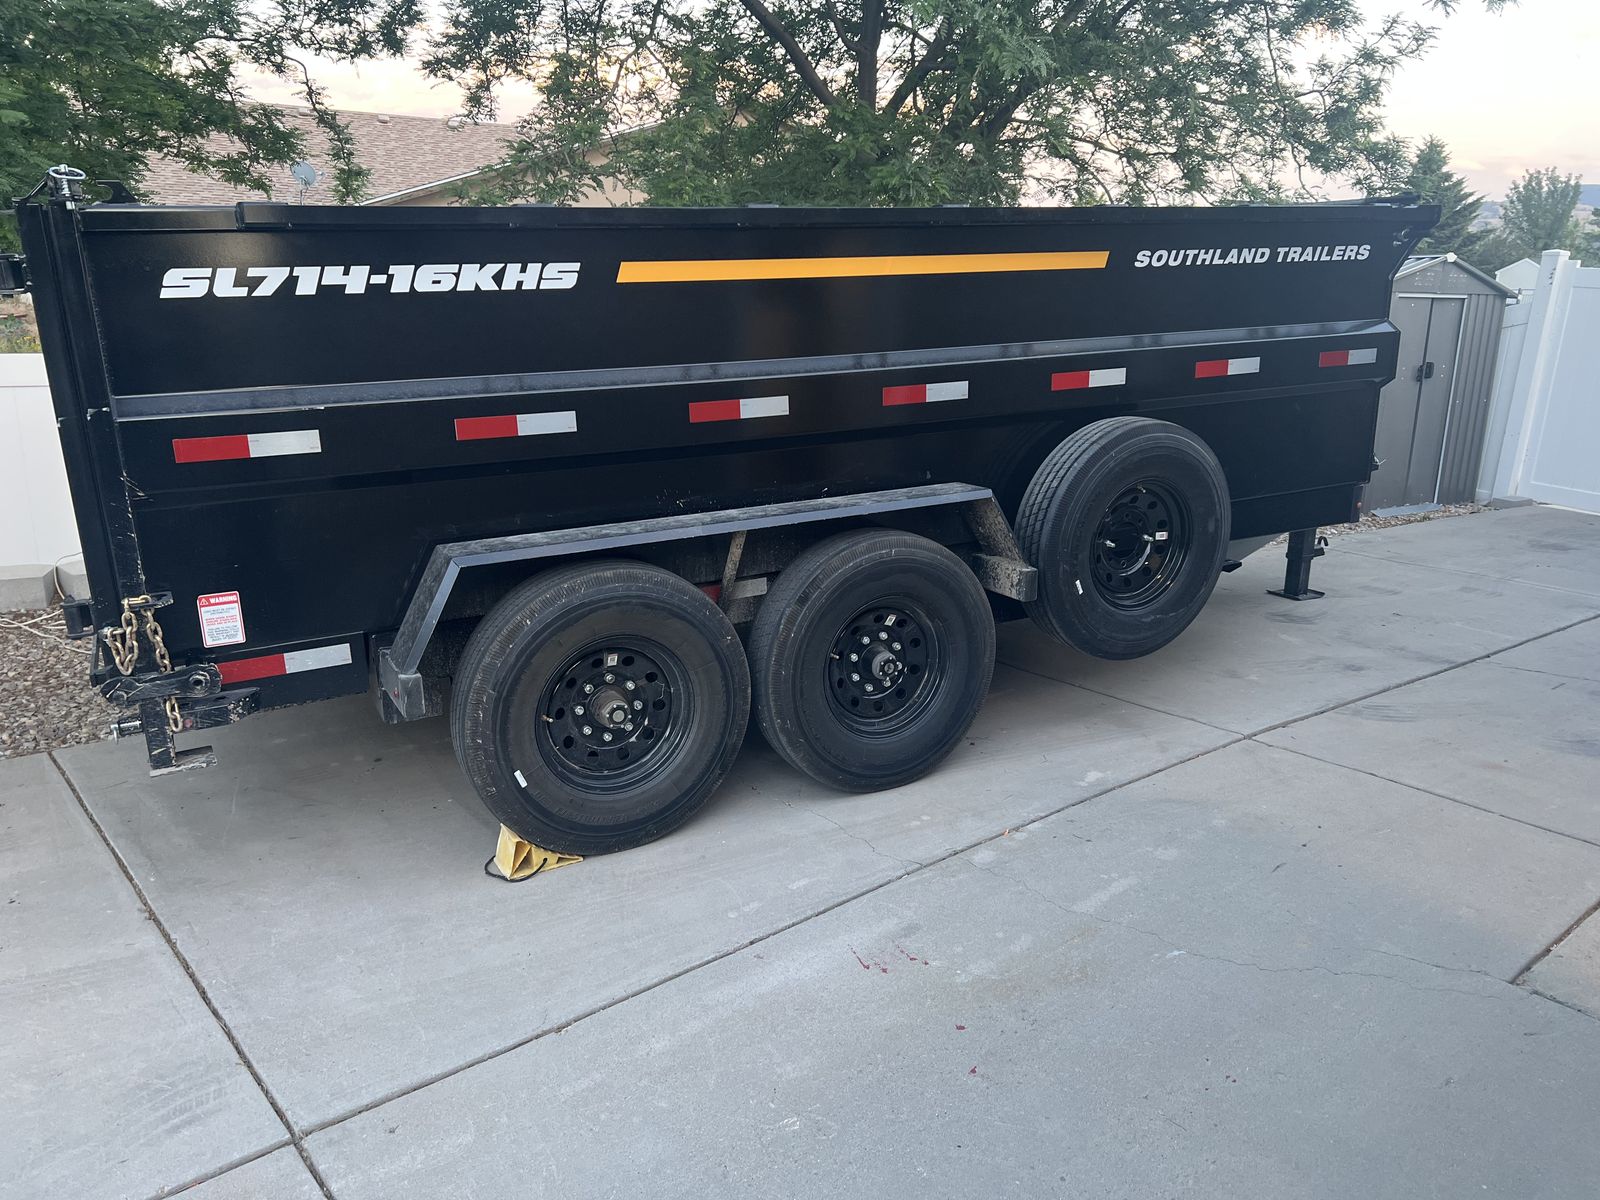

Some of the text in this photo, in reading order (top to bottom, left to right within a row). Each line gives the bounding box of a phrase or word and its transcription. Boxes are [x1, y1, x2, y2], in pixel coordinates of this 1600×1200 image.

[1134, 244, 1371, 268] SOUTHLAND TRAILERS
[159, 262, 581, 299] SL714-16KHS
[209, 595, 237, 604] WARNING
